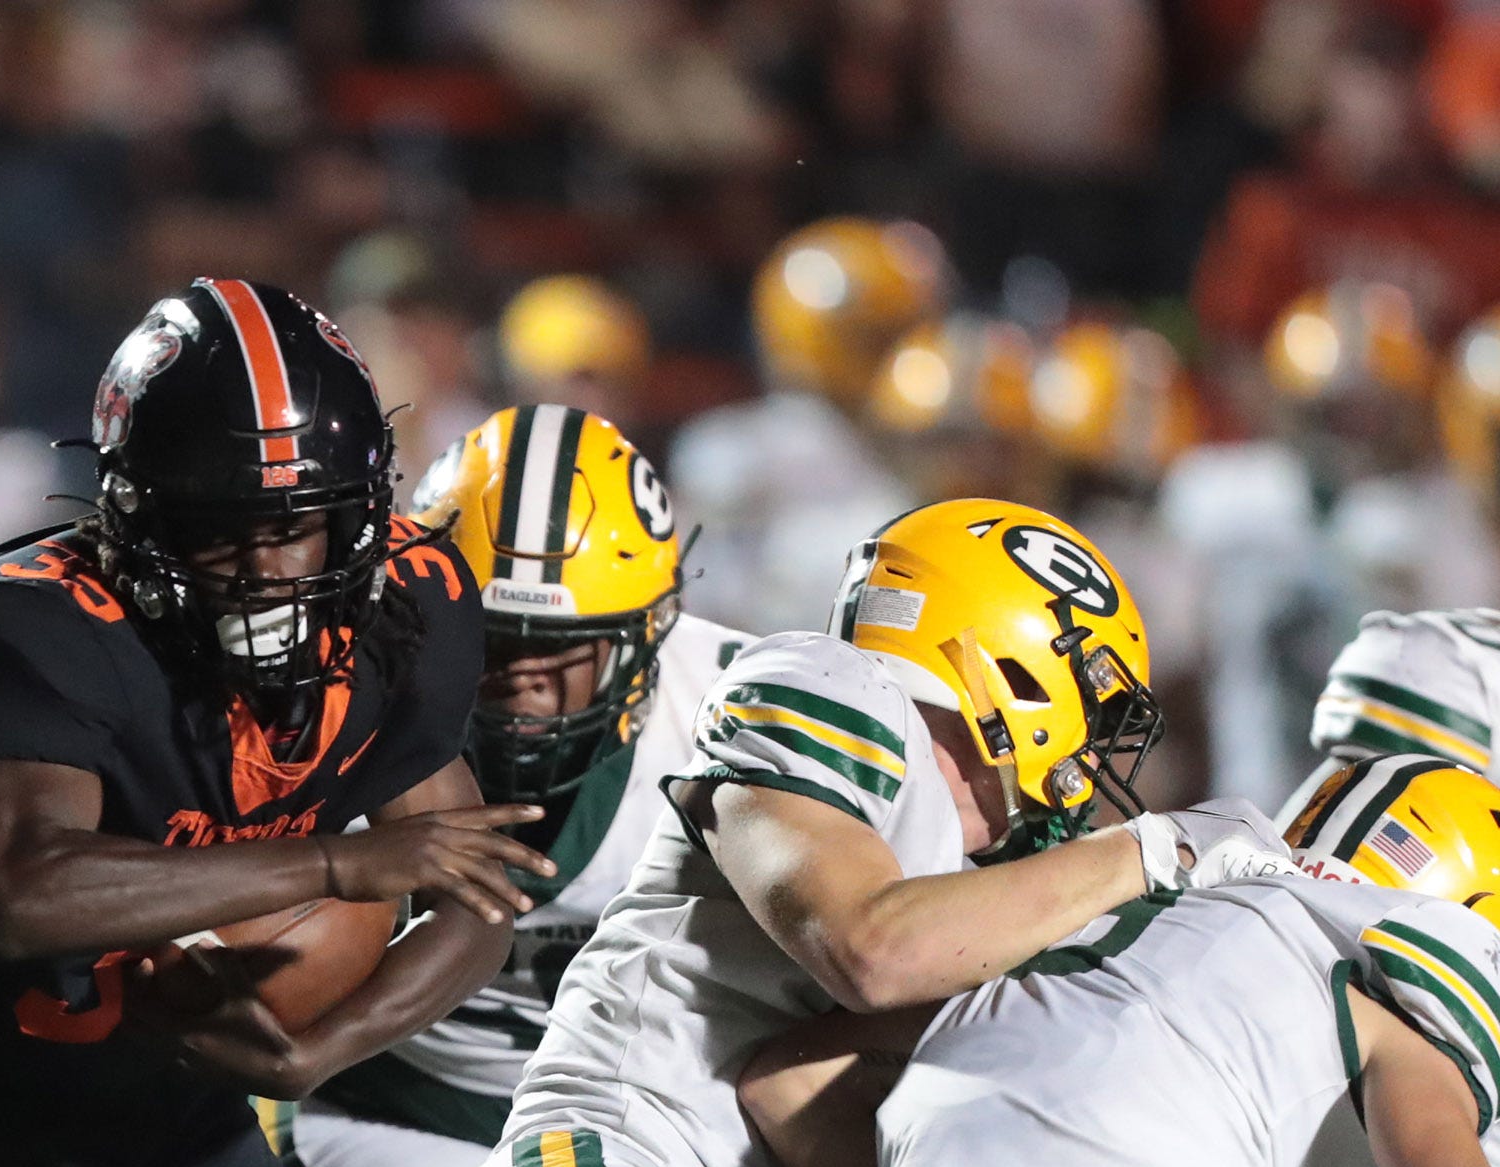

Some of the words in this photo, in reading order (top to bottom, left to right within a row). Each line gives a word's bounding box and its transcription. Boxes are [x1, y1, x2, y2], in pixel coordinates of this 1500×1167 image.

[261, 465, 299, 488] 126
[1012, 529, 1111, 610] E
[500, 588, 549, 605] EAGLES
